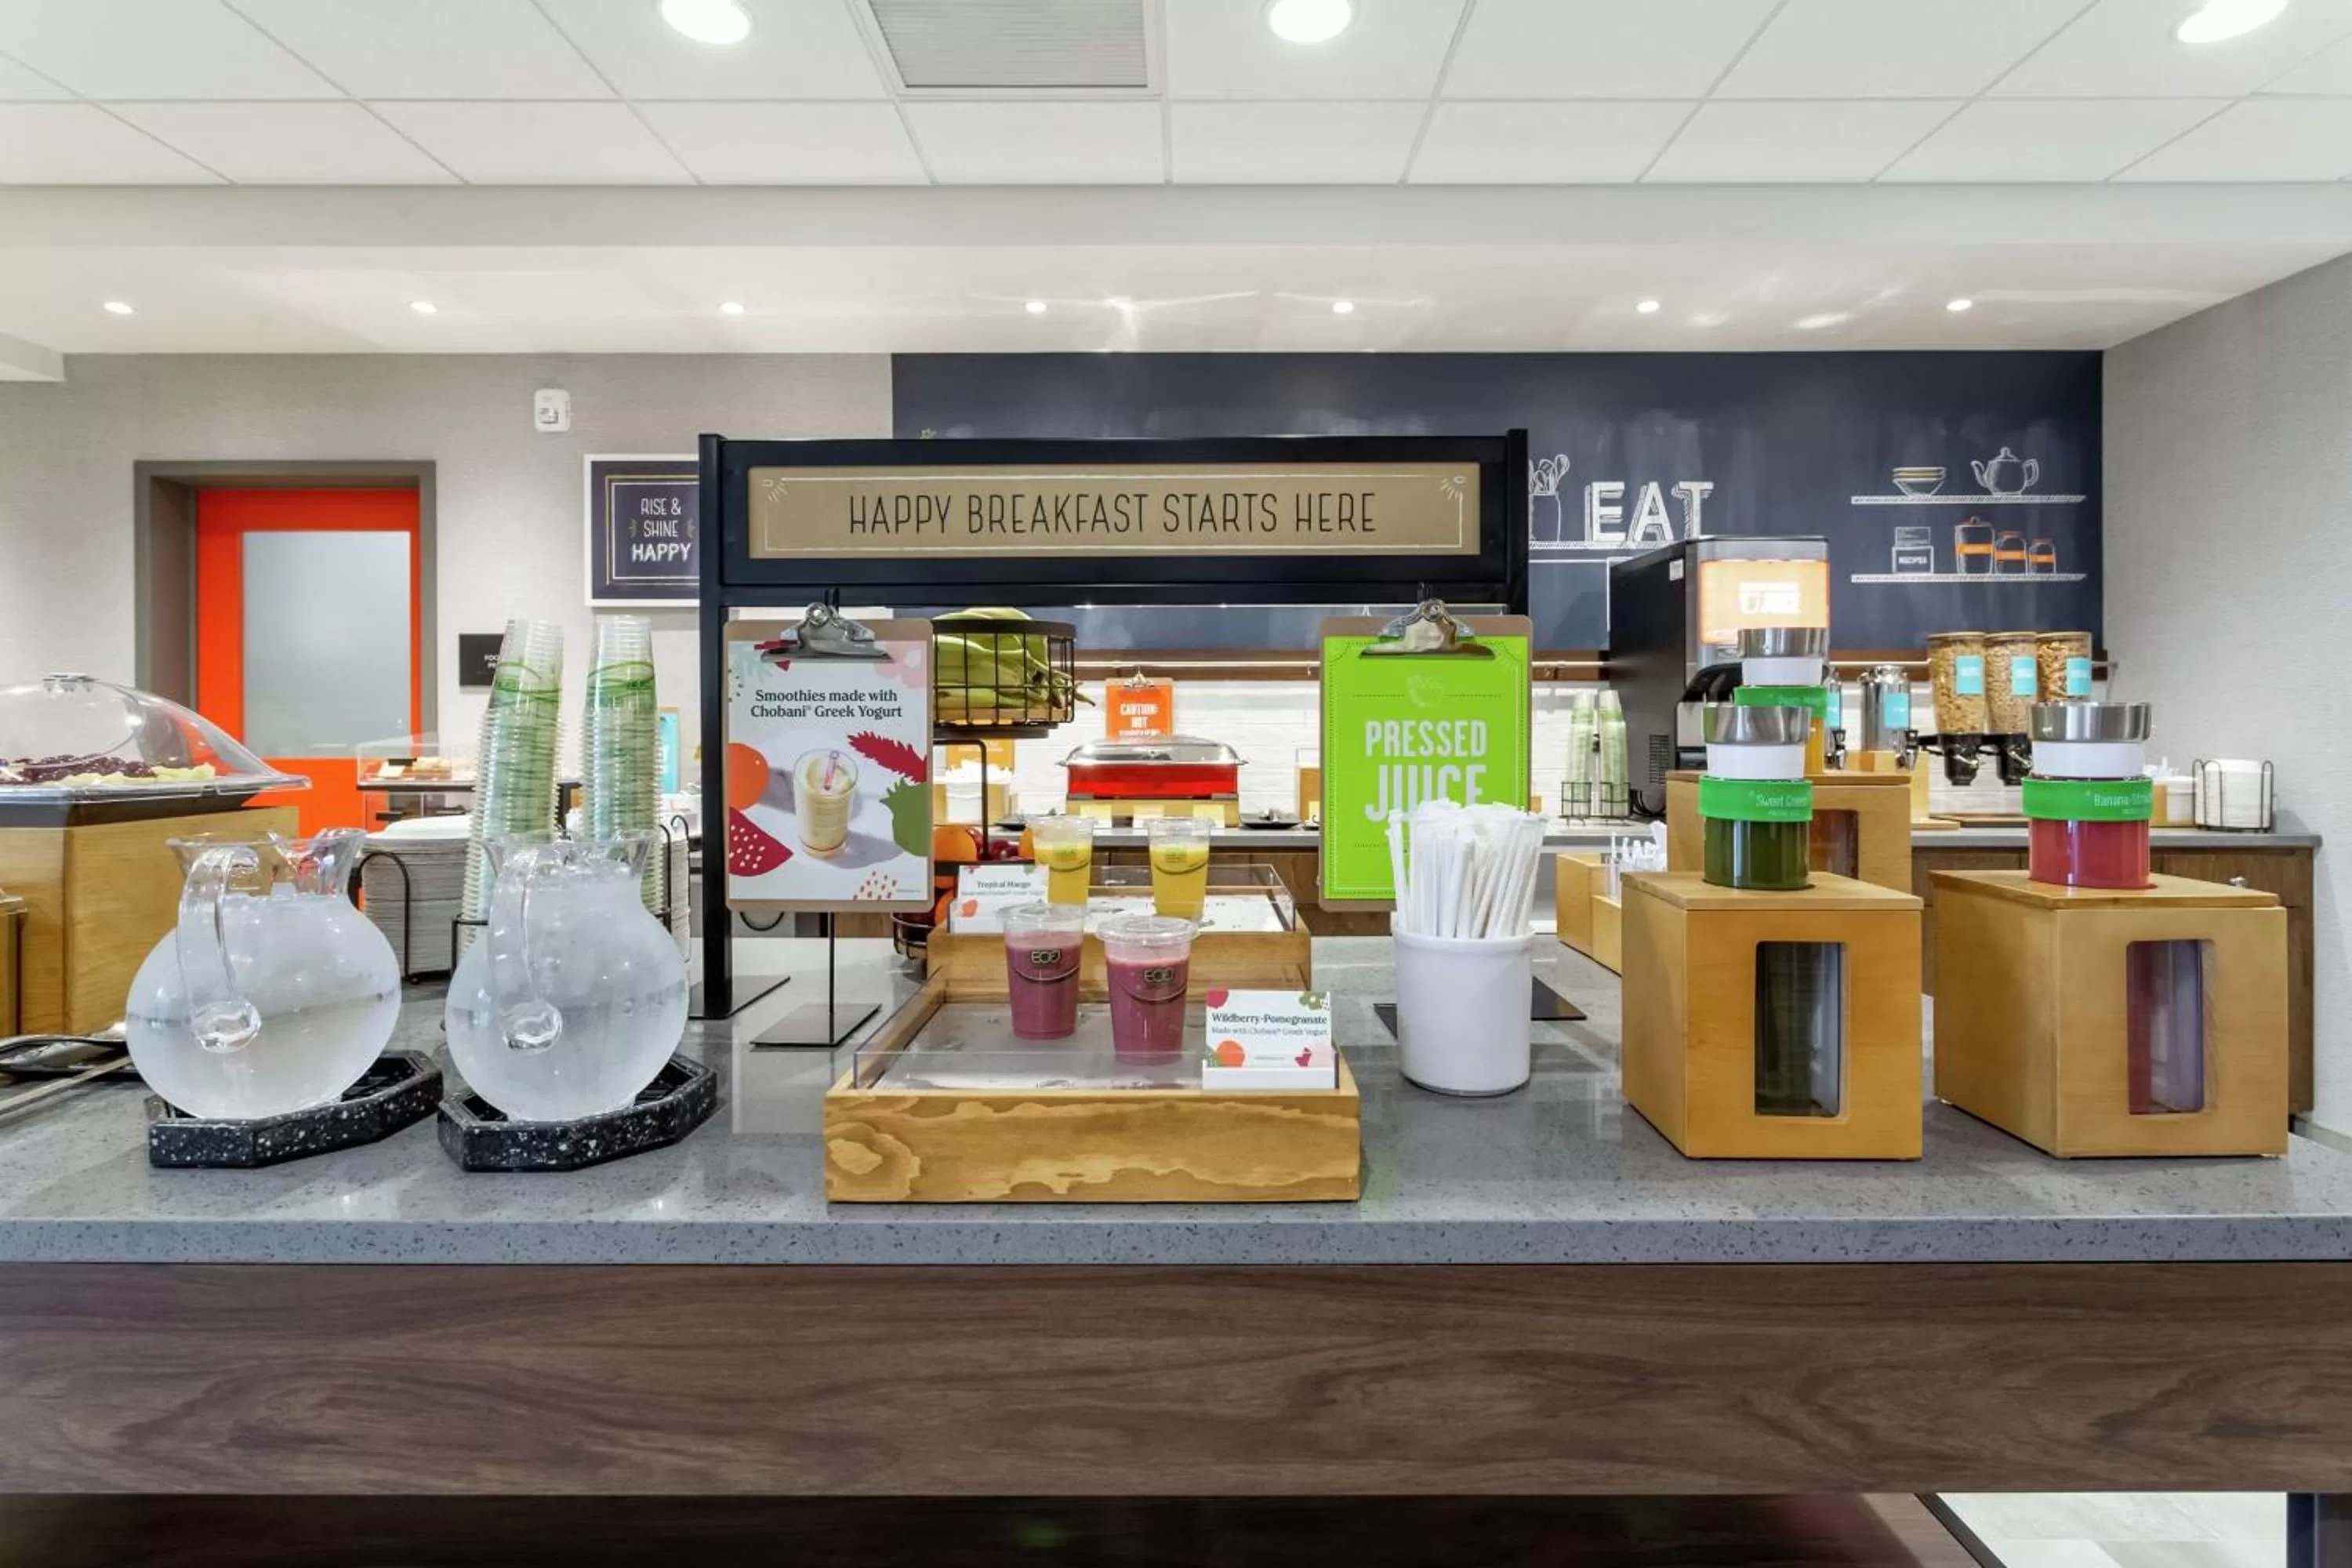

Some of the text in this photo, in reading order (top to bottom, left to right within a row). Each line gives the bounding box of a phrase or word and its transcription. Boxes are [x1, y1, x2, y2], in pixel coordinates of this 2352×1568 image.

[641, 497, 681, 515] RISE &
[850, 492, 1377, 534] HAPPY BREAKFAST STARTS HERE
[1585, 481, 1714, 545] EAT
[644, 520, 679, 537] SHINE
[632, 543, 691, 563] HAPPY
[755, 689, 898, 702] Smoothies made with
[815, 705, 855, 717] Greek
[858, 705, 902, 720] Yogurt
[1364, 720, 1487, 757] PRESSED
[1364, 764, 1487, 822] JUICE
[977, 880, 1031, 889] Tropical Mango
